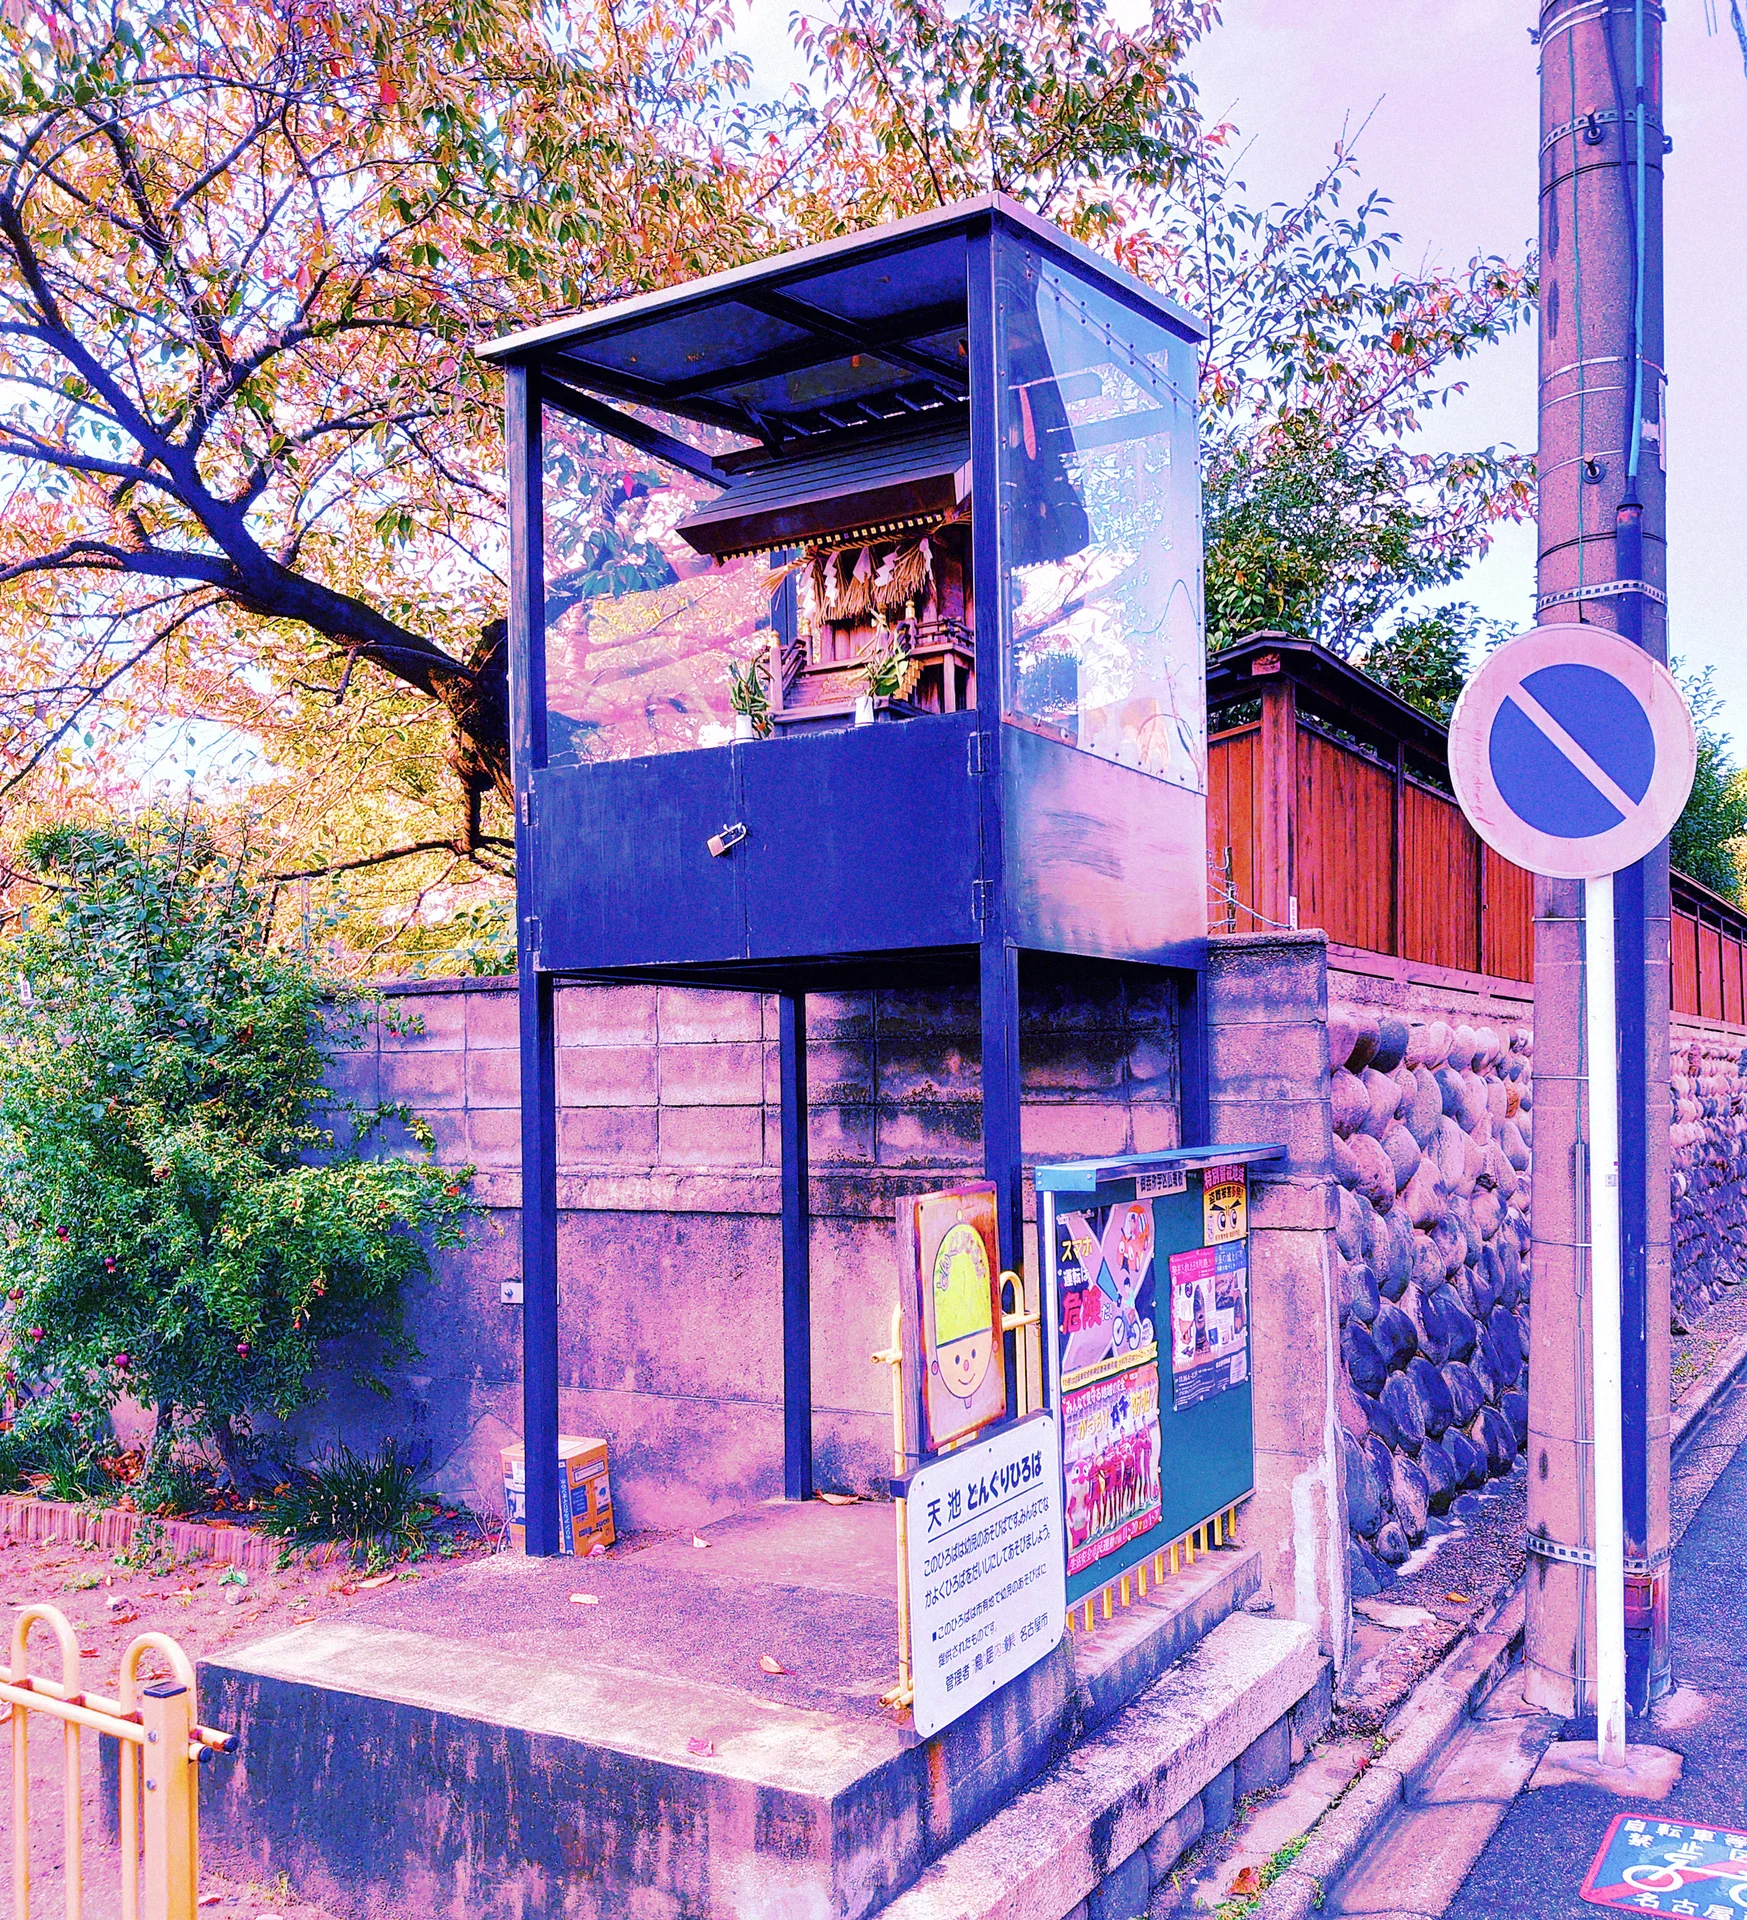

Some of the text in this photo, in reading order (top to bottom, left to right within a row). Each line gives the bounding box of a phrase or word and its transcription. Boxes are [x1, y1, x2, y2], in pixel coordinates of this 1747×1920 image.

[1061, 1236, 1093, 1262] スマホ
[1063, 1267, 1090, 1288] 運転は
[945, 1612, 1049, 1692] 管理者 名古屋市
[1633, 1892, 1747, 1920] 名古屋
